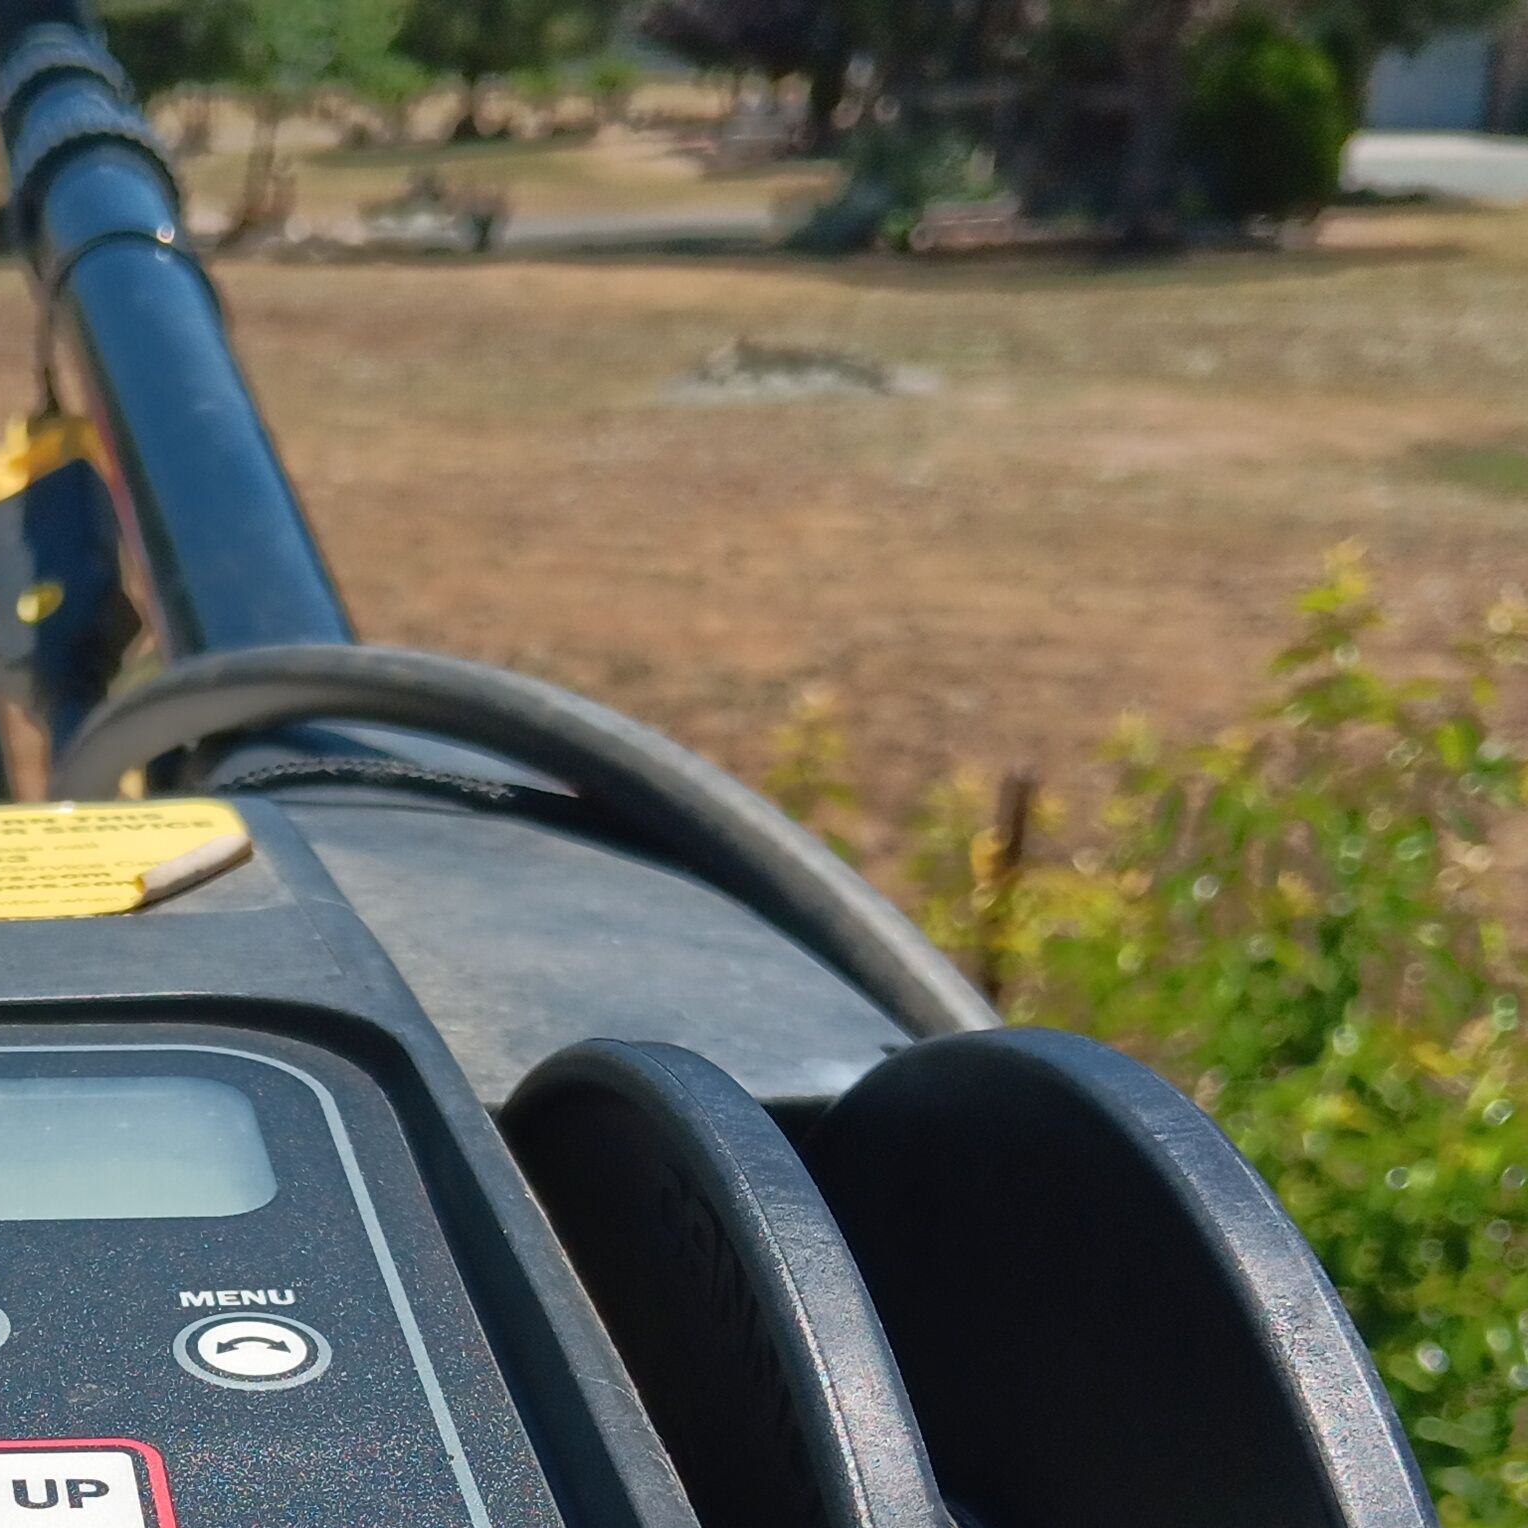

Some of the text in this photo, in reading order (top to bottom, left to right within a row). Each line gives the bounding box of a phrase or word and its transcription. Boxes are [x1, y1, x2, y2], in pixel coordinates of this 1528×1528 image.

[73, 813, 164, 823] THIS
[42, 820, 216, 834] SERVICE
[179, 1288, 297, 1307] MENU
[12, 1476, 111, 1511] UP
